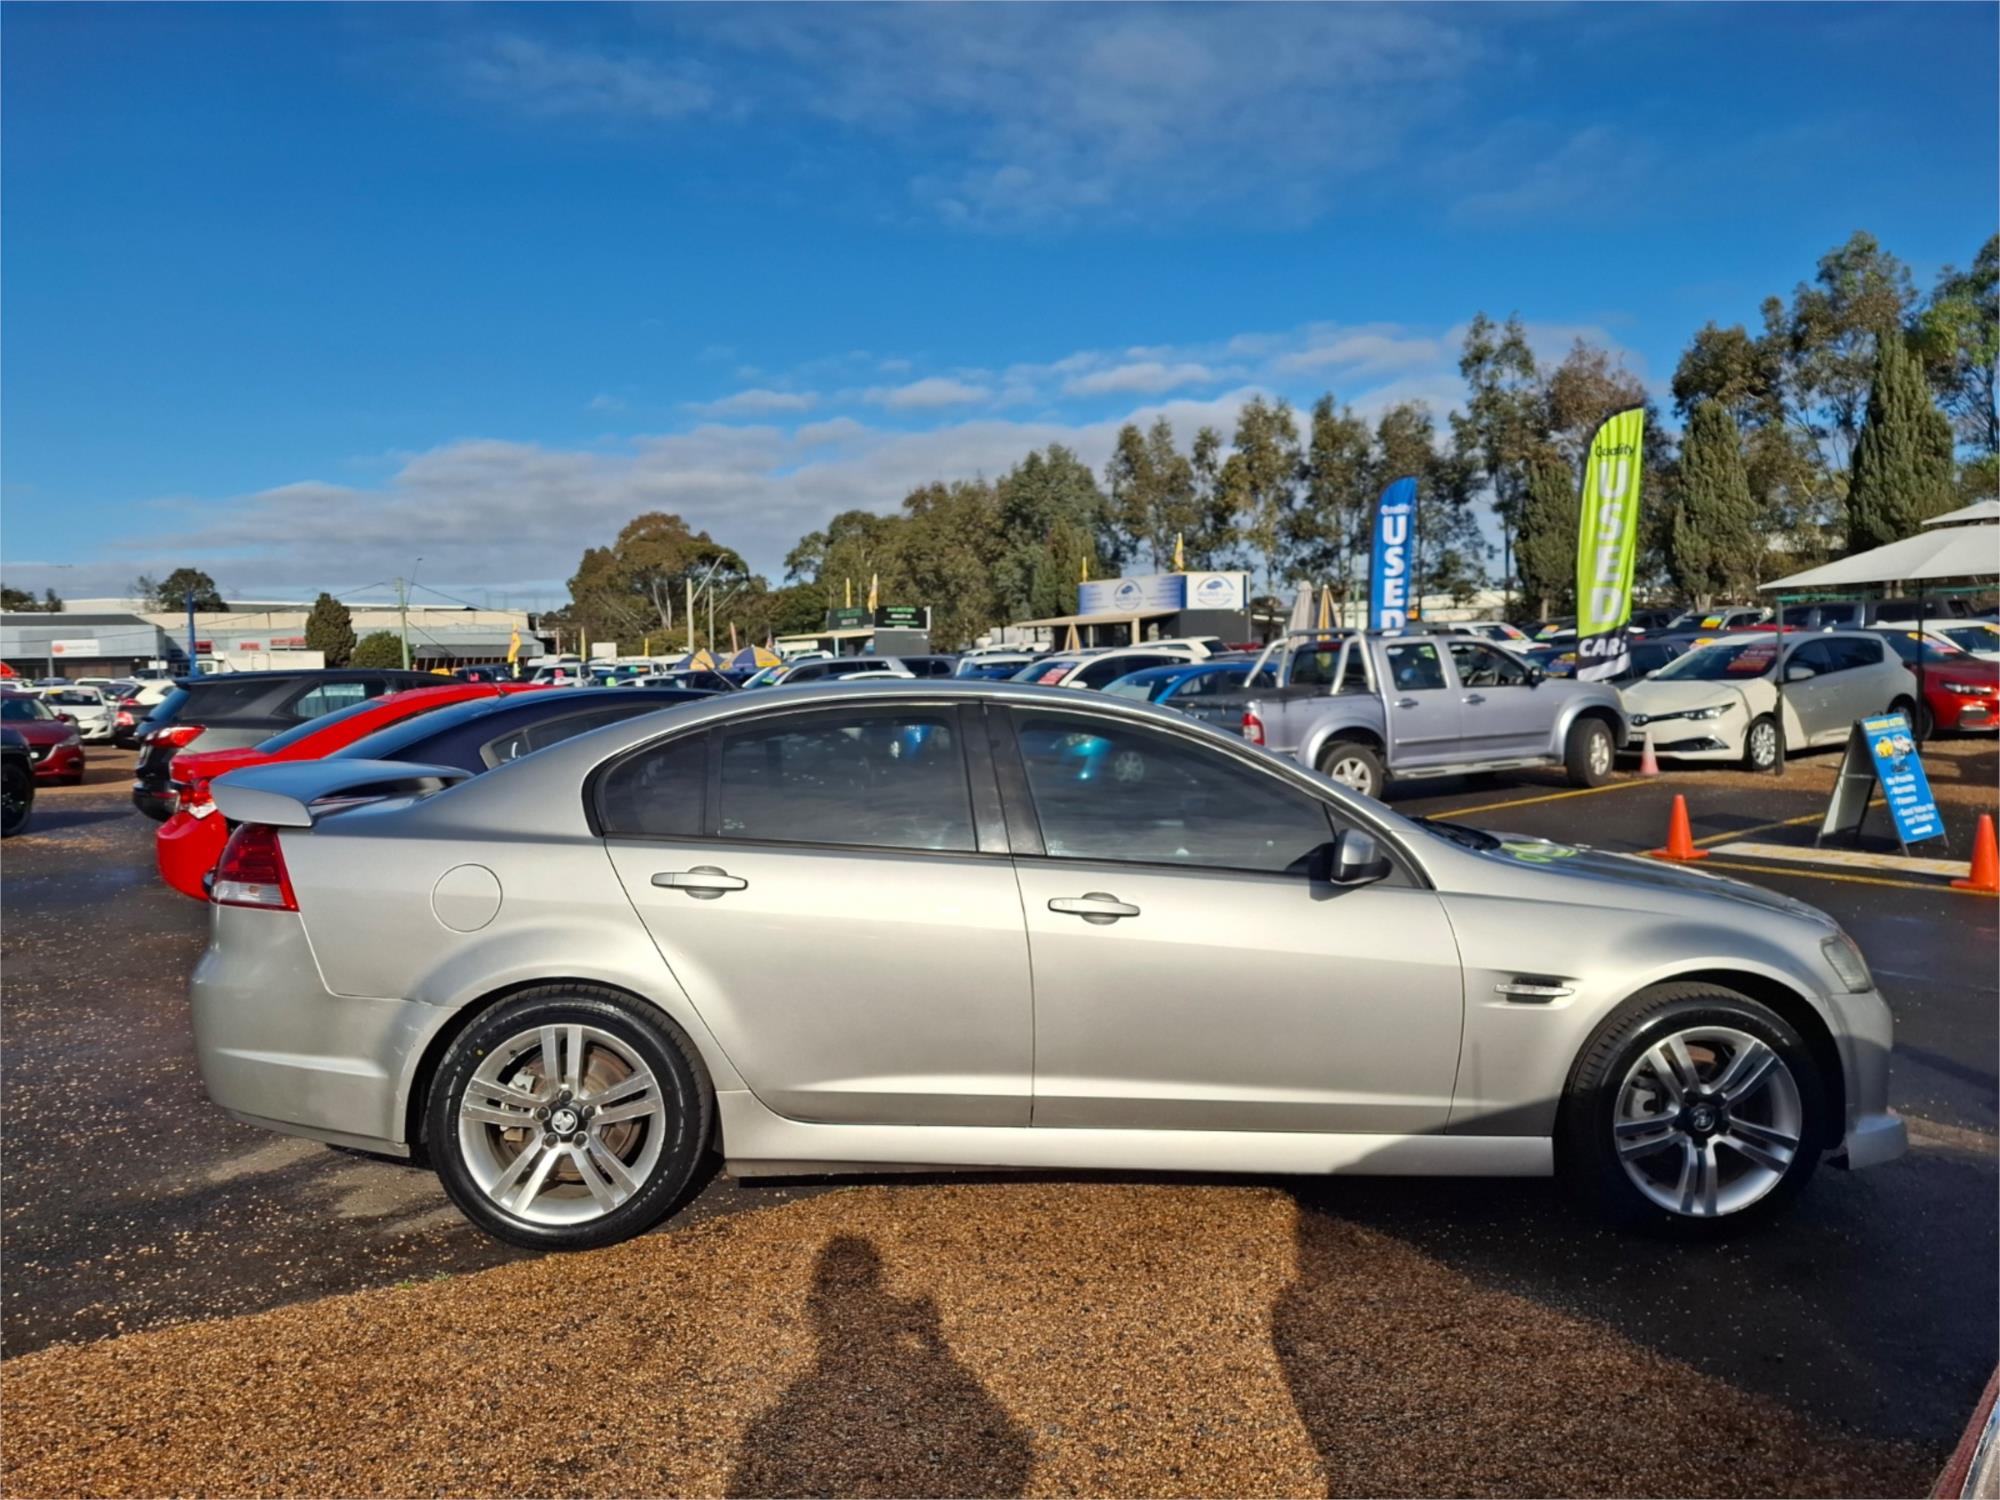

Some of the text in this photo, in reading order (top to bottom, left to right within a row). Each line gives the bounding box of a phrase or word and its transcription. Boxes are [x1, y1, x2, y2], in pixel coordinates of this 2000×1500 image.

[1595, 443, 1634, 458] Quality
[1380, 514, 1408, 637] USED
[1591, 459, 1628, 625] USED
